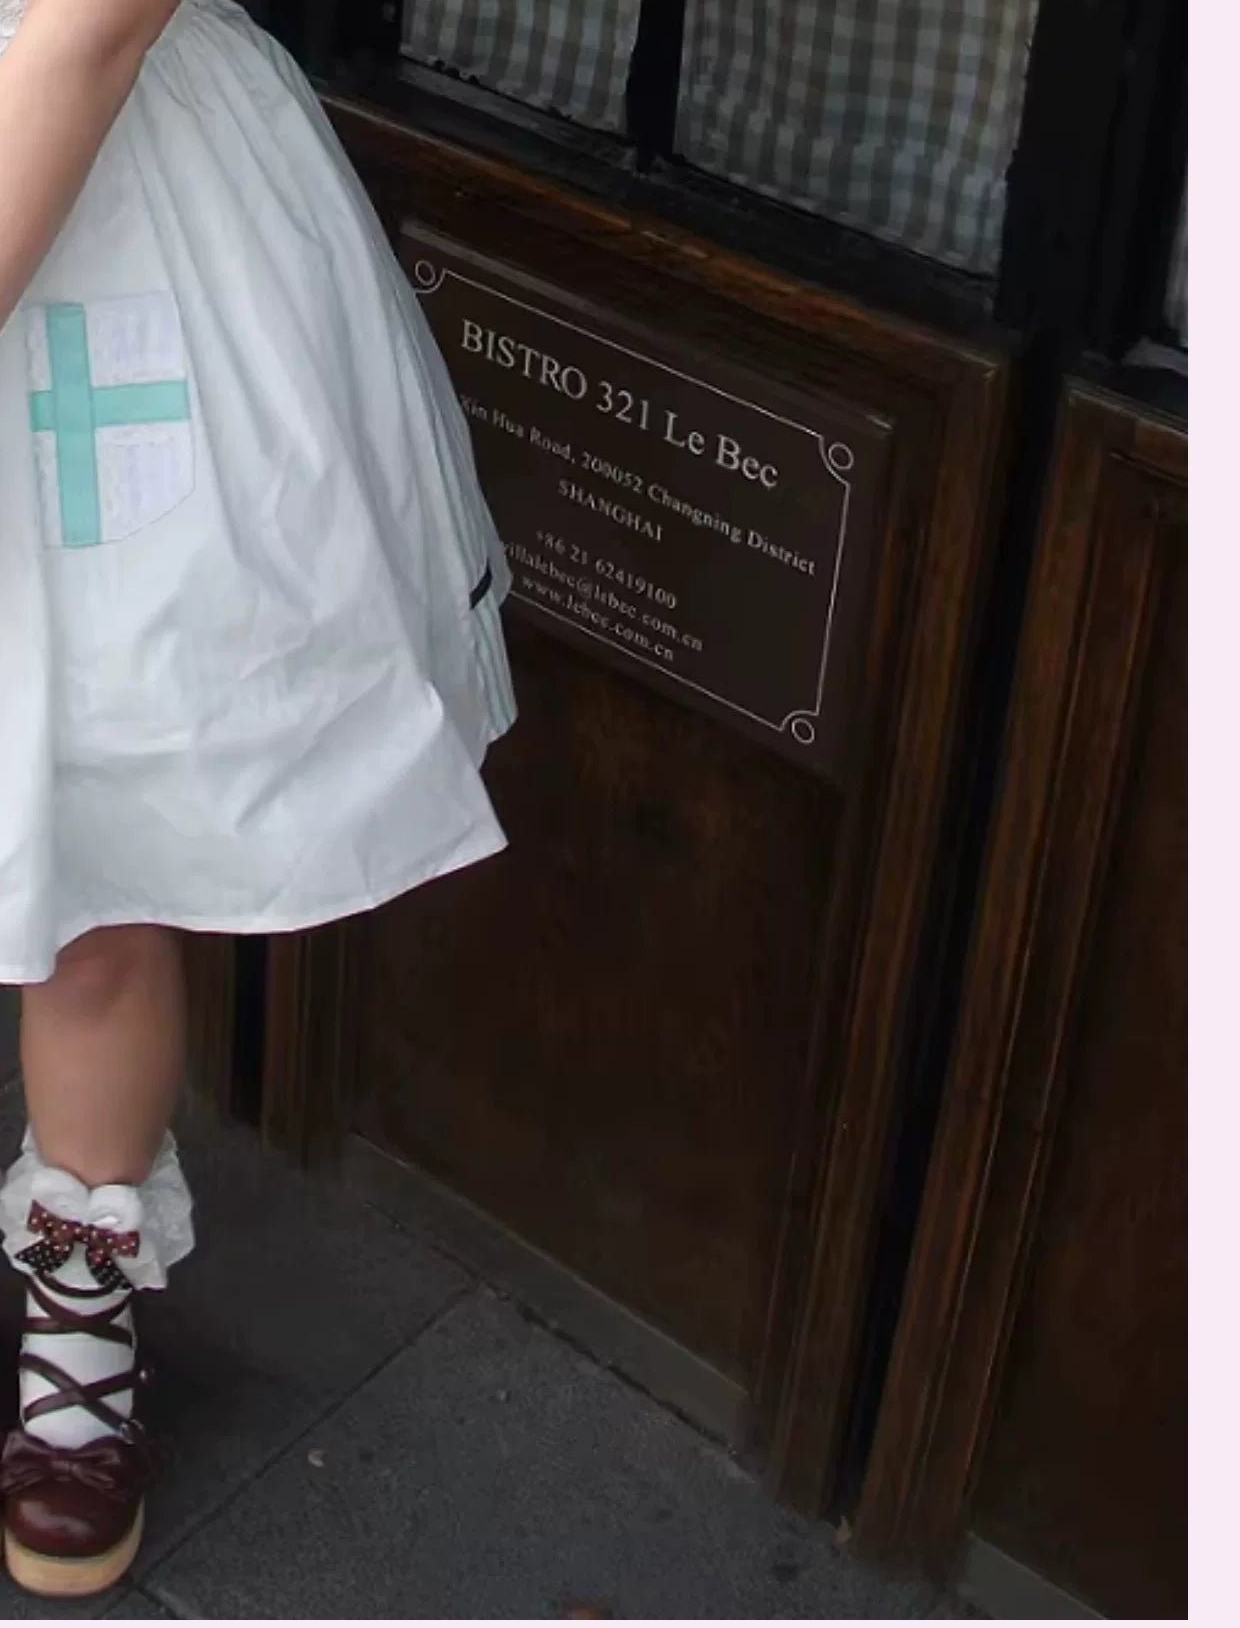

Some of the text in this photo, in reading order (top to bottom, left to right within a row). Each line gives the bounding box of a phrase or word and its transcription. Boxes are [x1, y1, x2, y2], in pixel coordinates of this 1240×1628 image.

[461, 317, 779, 490] BISTRO 321 Le Bec
[492, 407, 524, 439] Hua
[581, 450, 643, 494] 200052
[646, 482, 742, 544] Changning
[746, 529, 816, 577] District
[558, 479, 663, 542] SHANGHAI
[570, 543, 588, 566] 21
[521, 574, 675, 662] www.lebec.com.cn
